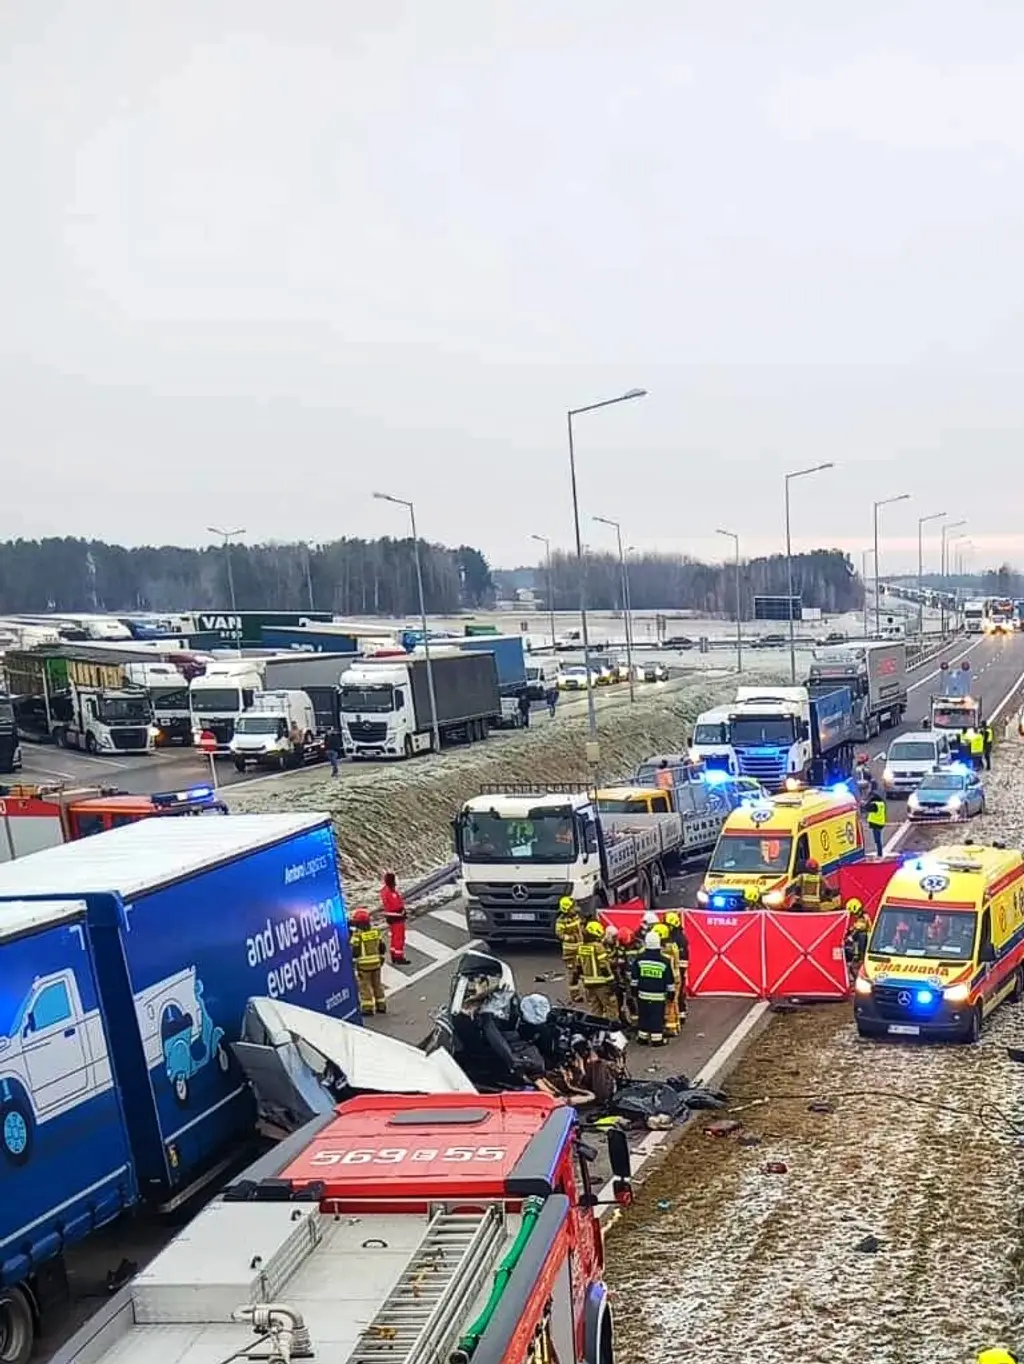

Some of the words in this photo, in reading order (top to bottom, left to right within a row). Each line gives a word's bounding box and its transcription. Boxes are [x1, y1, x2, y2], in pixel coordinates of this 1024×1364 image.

[201, 616, 242, 630] VAN
[246, 918, 275, 968] and
[275, 917, 299, 951] we
[300, 898, 335, 940] mean
[267, 928, 343, 998] everything!
